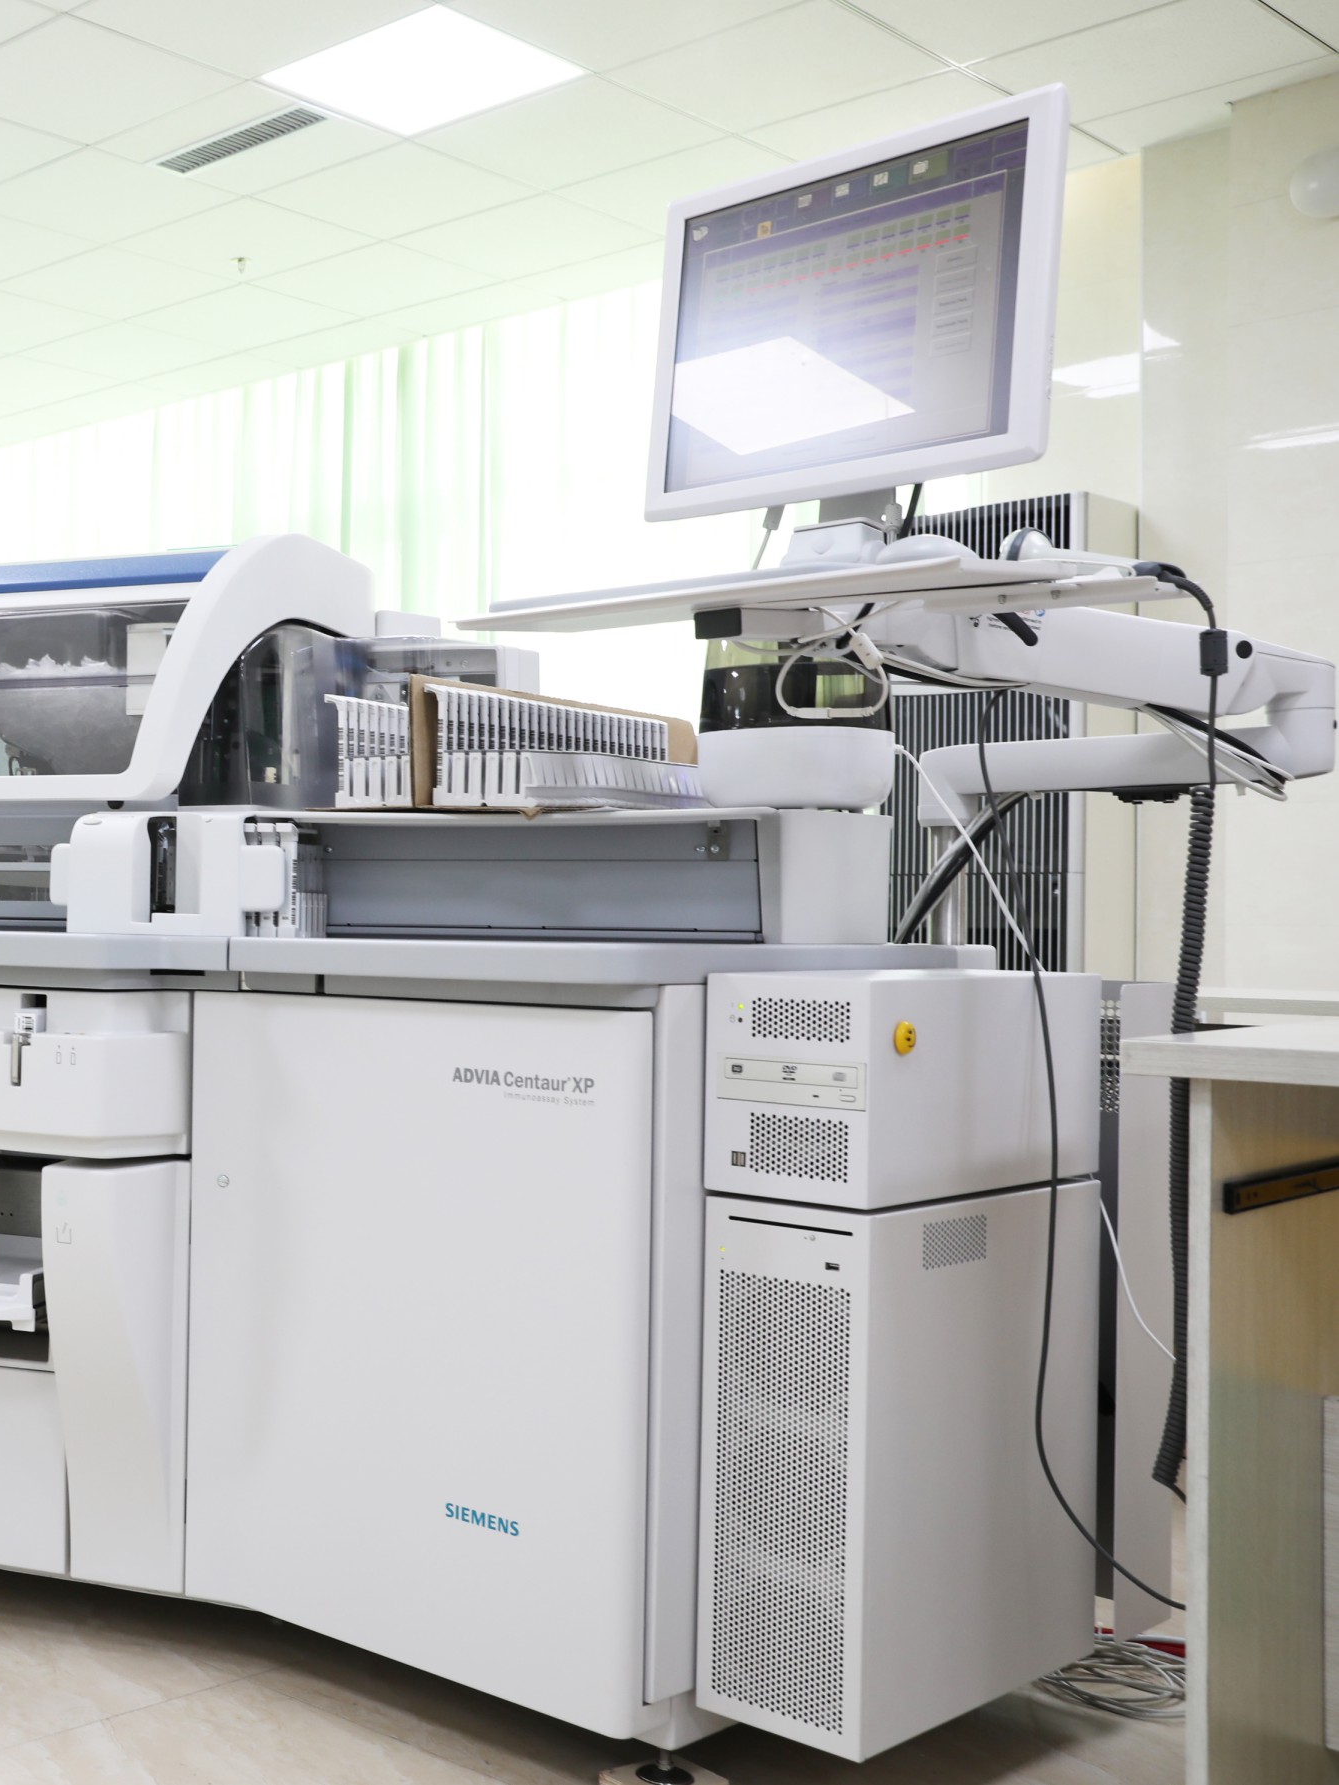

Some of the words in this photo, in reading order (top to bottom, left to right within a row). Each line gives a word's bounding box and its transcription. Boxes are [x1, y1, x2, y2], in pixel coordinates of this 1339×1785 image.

[452, 1066, 501, 1086] ADVIA
[572, 1076, 595, 1094] XP
[503, 1091, 561, 1106] Immunoassay
[563, 1096, 596, 1107] System
[445, 1502, 520, 1537] SIEMENS
